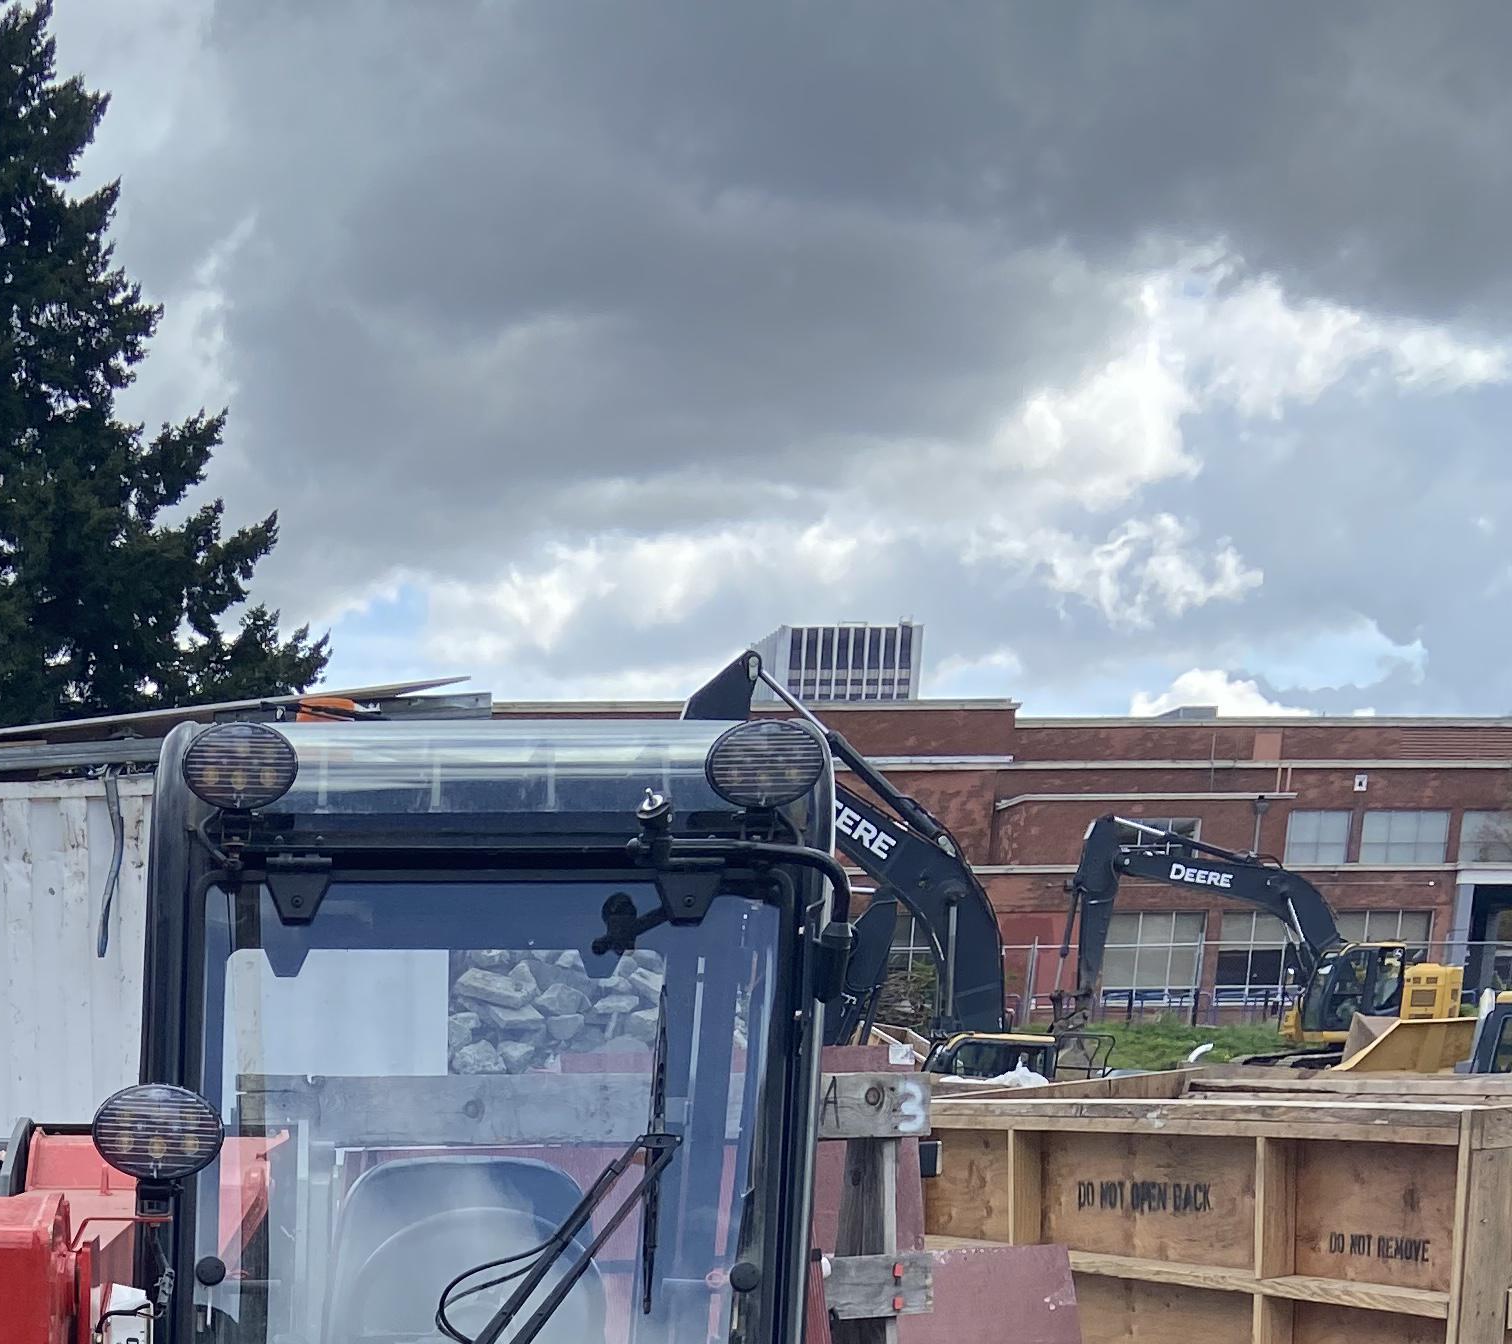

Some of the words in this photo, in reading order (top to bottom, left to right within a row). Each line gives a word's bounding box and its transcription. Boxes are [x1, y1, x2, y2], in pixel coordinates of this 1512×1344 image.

[835, 800, 897, 860] ERE
[1169, 863, 1234, 888] DEERE
[897, 1081, 925, 1132] 3
[1078, 1180, 1094, 1211] DO
[1100, 1181, 1124, 1211] NOT
[1131, 1180, 1168, 1213] OPEN
[1173, 1182, 1213, 1213] BACK
[1329, 1231, 1345, 1254] DO
[1350, 1233, 1372, 1256] NOT
[1377, 1235, 1431, 1262] REMOVE
